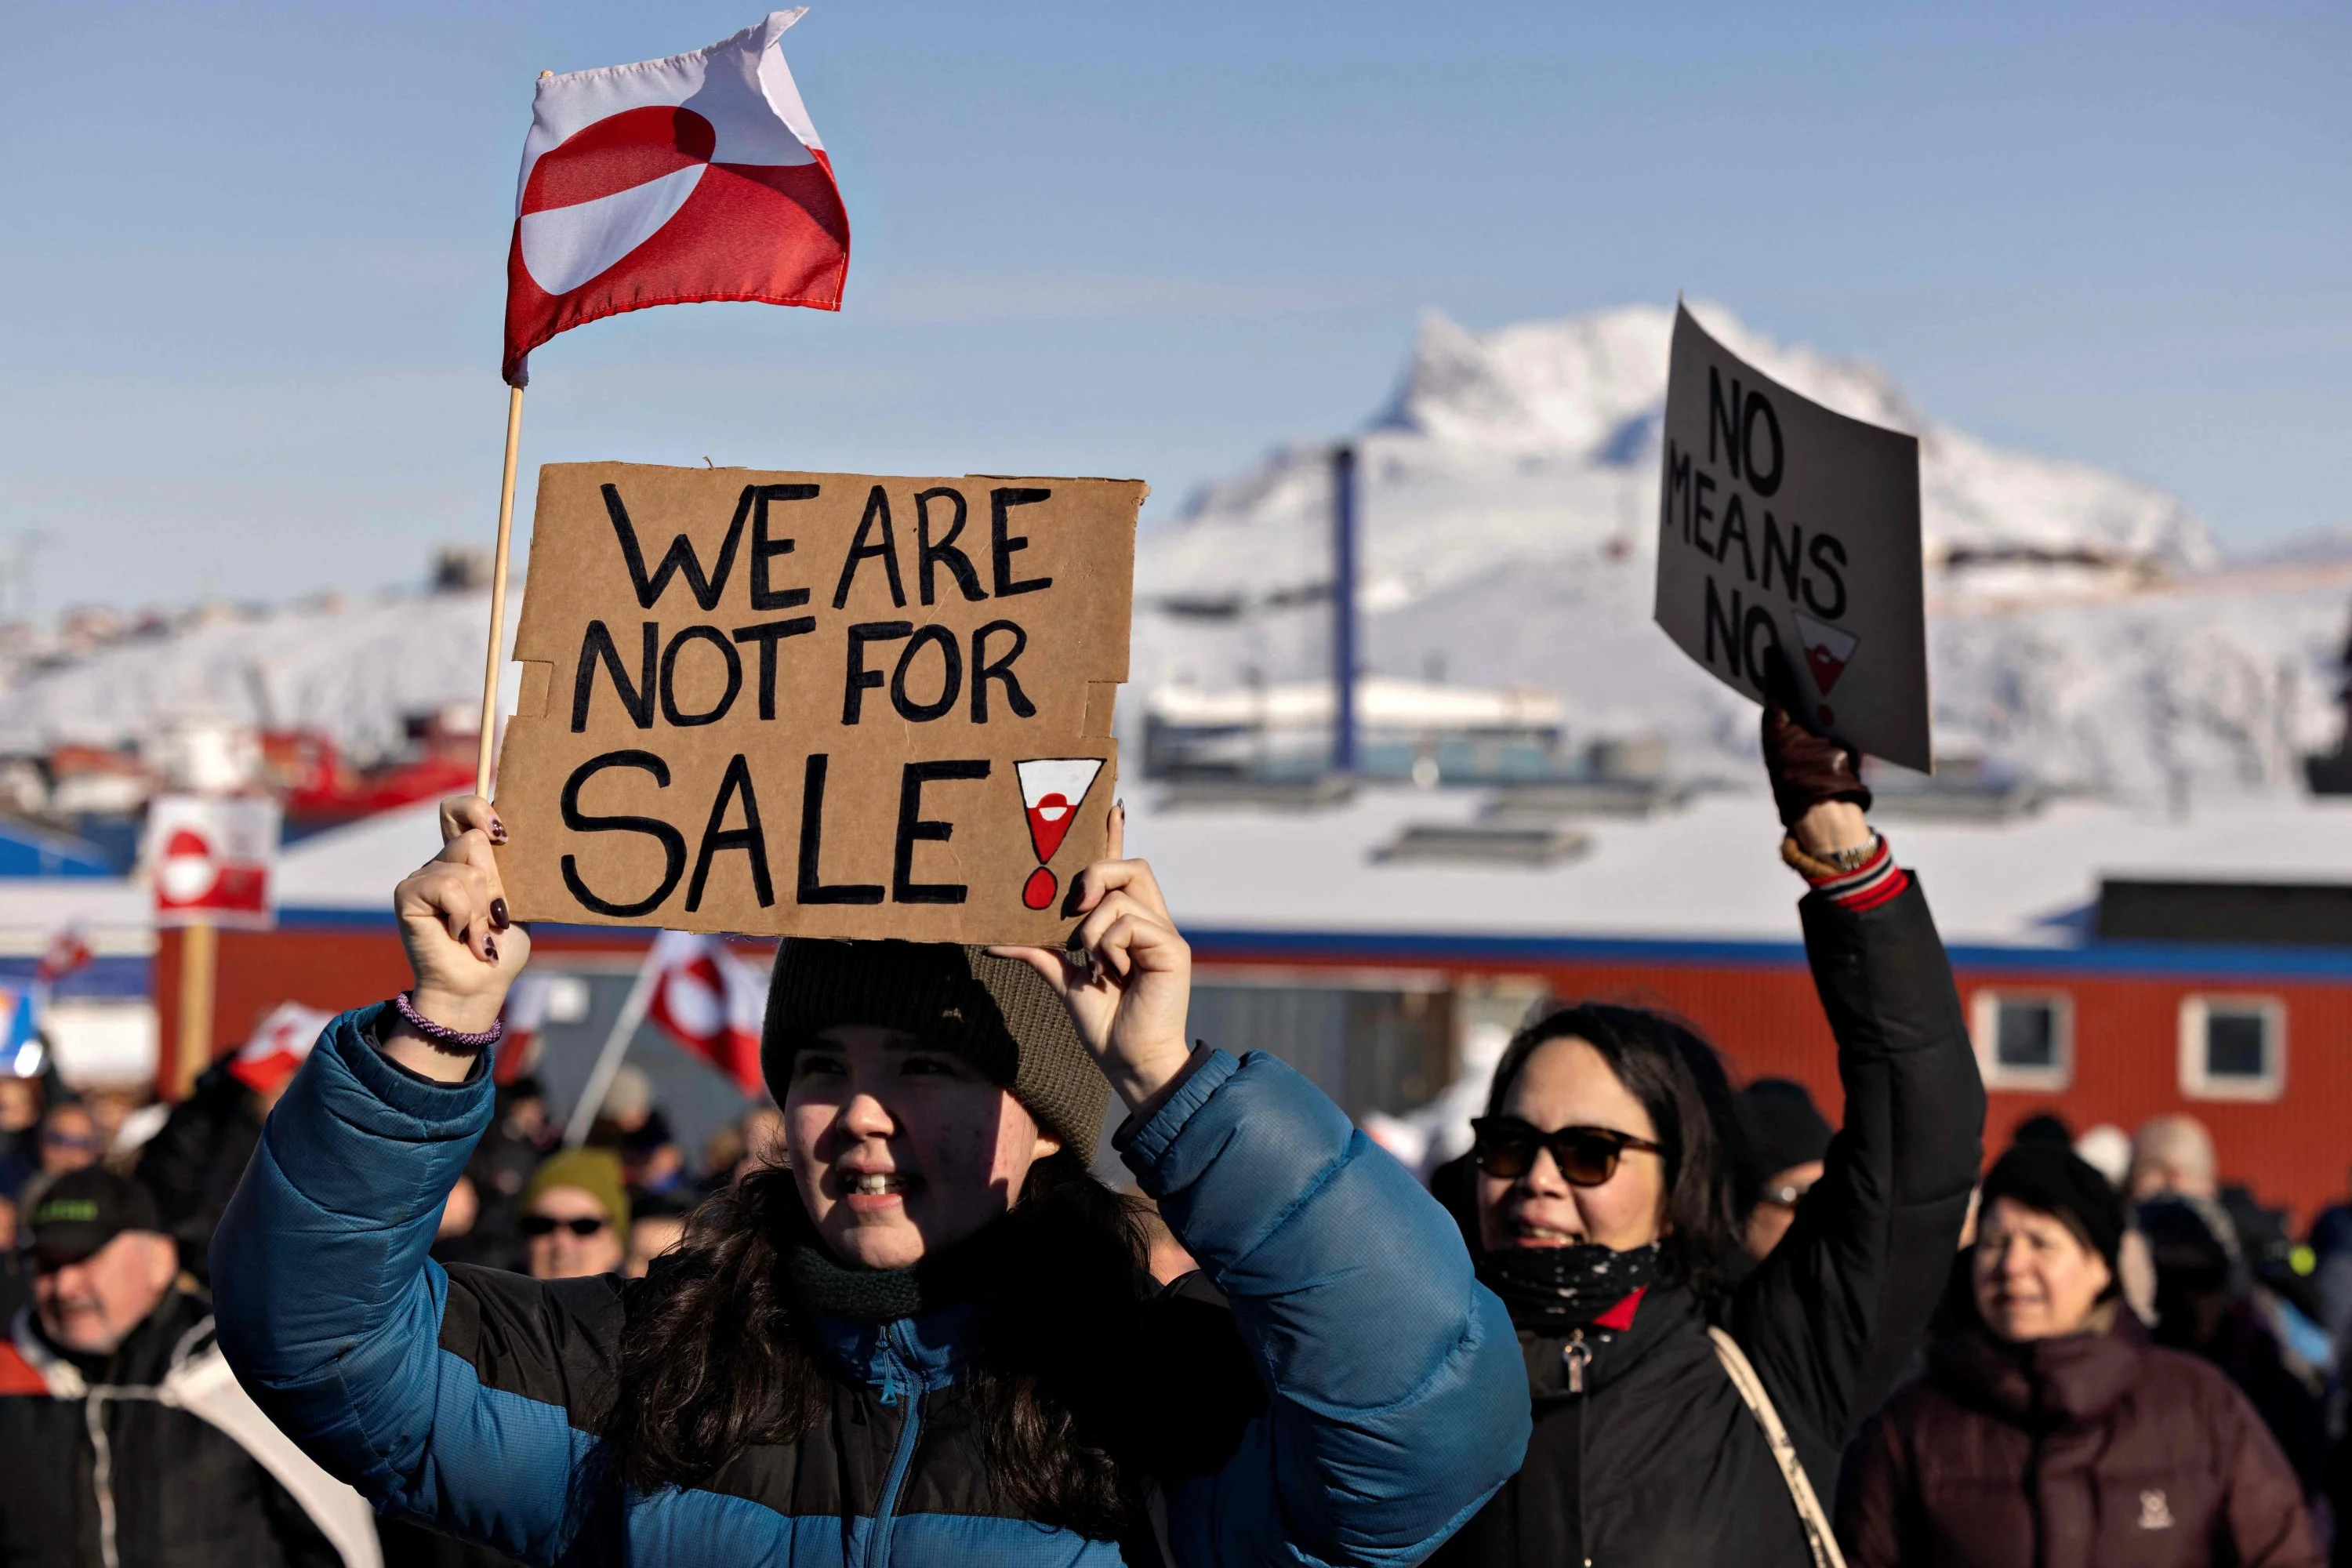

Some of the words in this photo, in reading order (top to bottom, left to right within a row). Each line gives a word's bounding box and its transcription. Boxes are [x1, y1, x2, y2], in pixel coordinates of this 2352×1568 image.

[1709, 365, 1784, 498] NO
[600, 483, 820, 612] WE
[832, 485, 1053, 610] ARE
[1667, 439, 1847, 620] MEANS
[571, 615, 816, 733] NOT
[840, 619, 1037, 726] FOR
